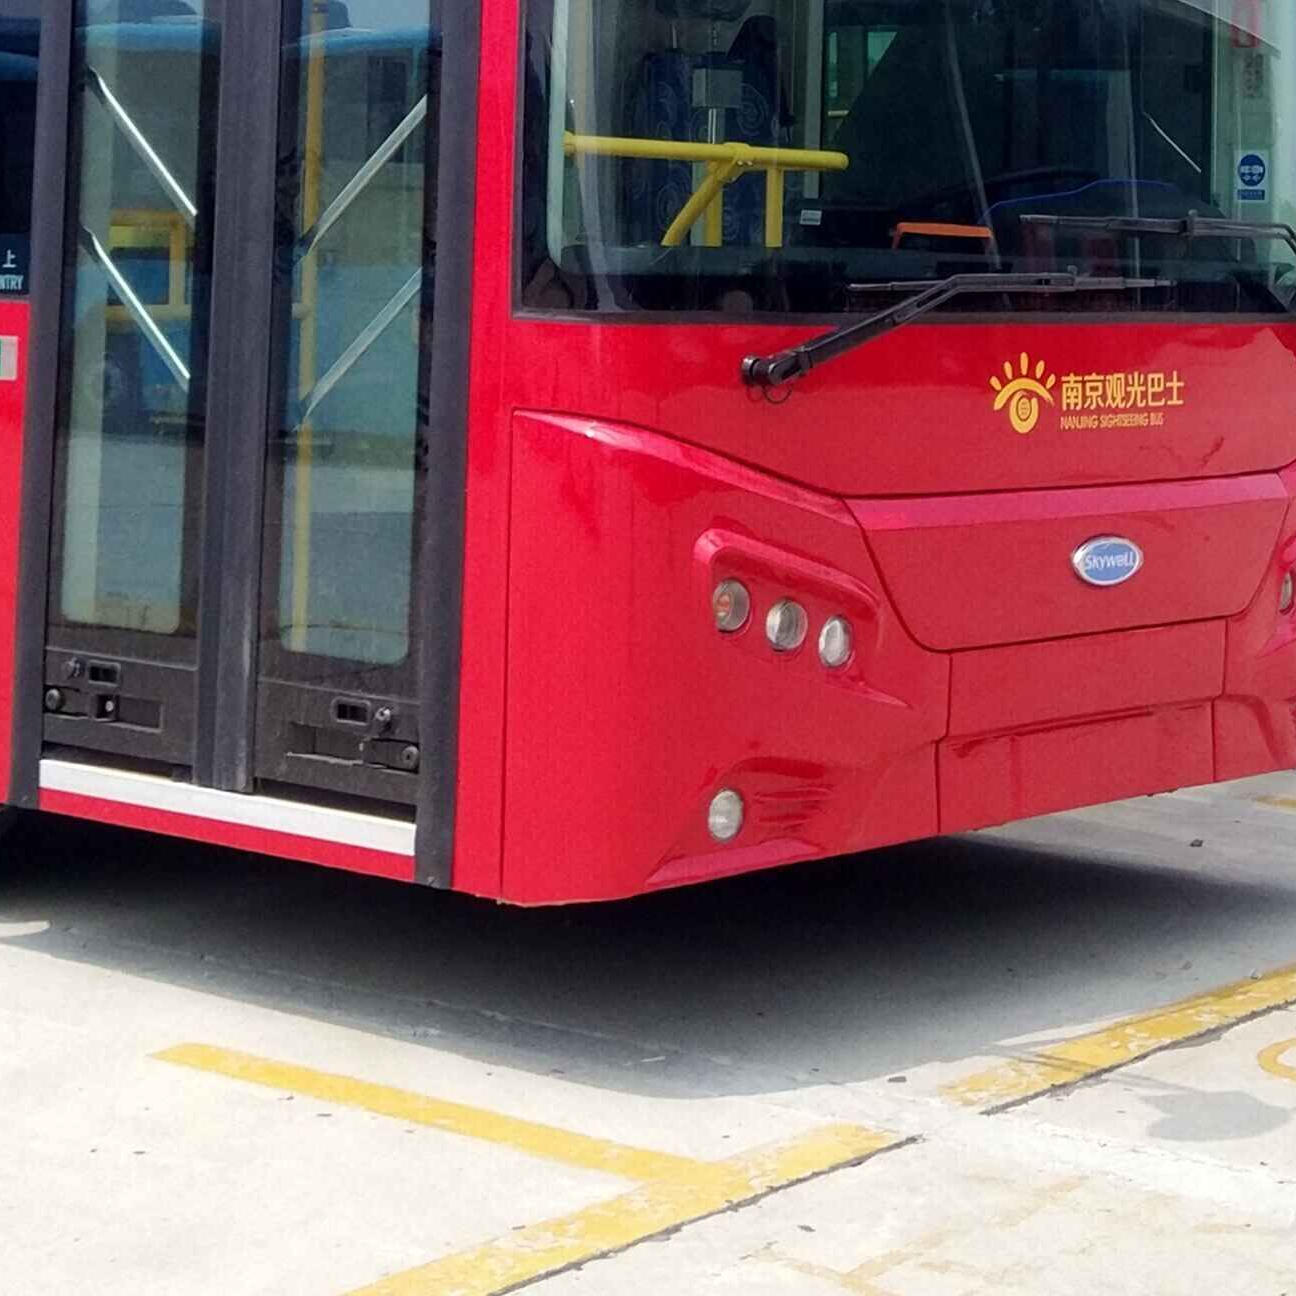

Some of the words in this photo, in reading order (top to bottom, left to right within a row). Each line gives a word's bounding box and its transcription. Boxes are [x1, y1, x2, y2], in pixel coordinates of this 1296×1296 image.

[1061, 370, 1185, 411] 南京观光巴士
